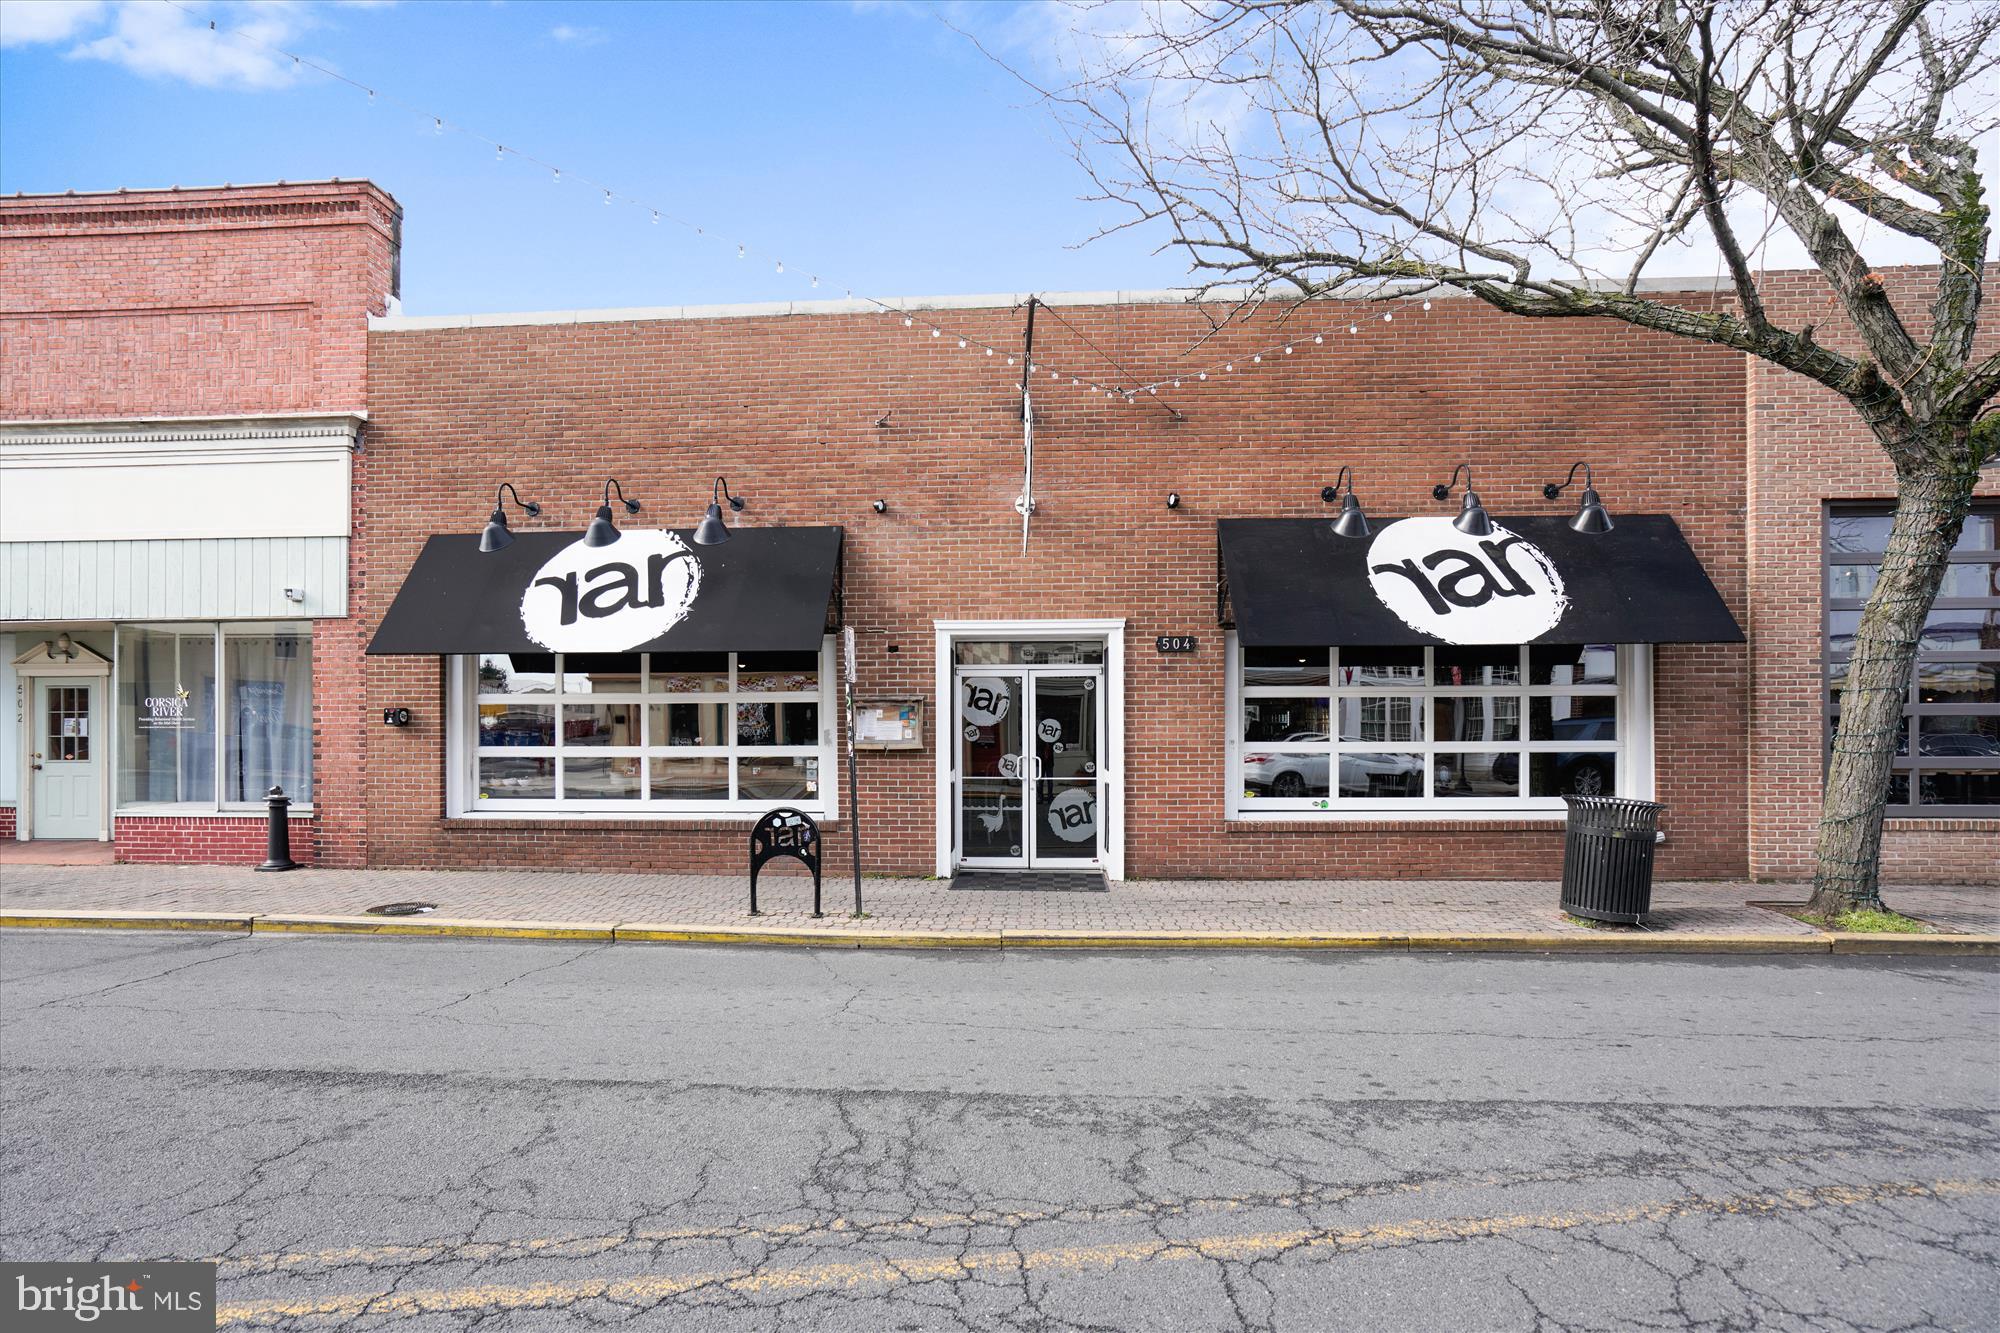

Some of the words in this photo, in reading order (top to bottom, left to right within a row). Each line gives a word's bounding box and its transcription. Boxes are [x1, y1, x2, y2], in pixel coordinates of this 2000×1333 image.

[1162, 638, 1190, 650] 504
[144, 697, 189, 708] CORSICA
[152, 707, 183, 717] RIVER
